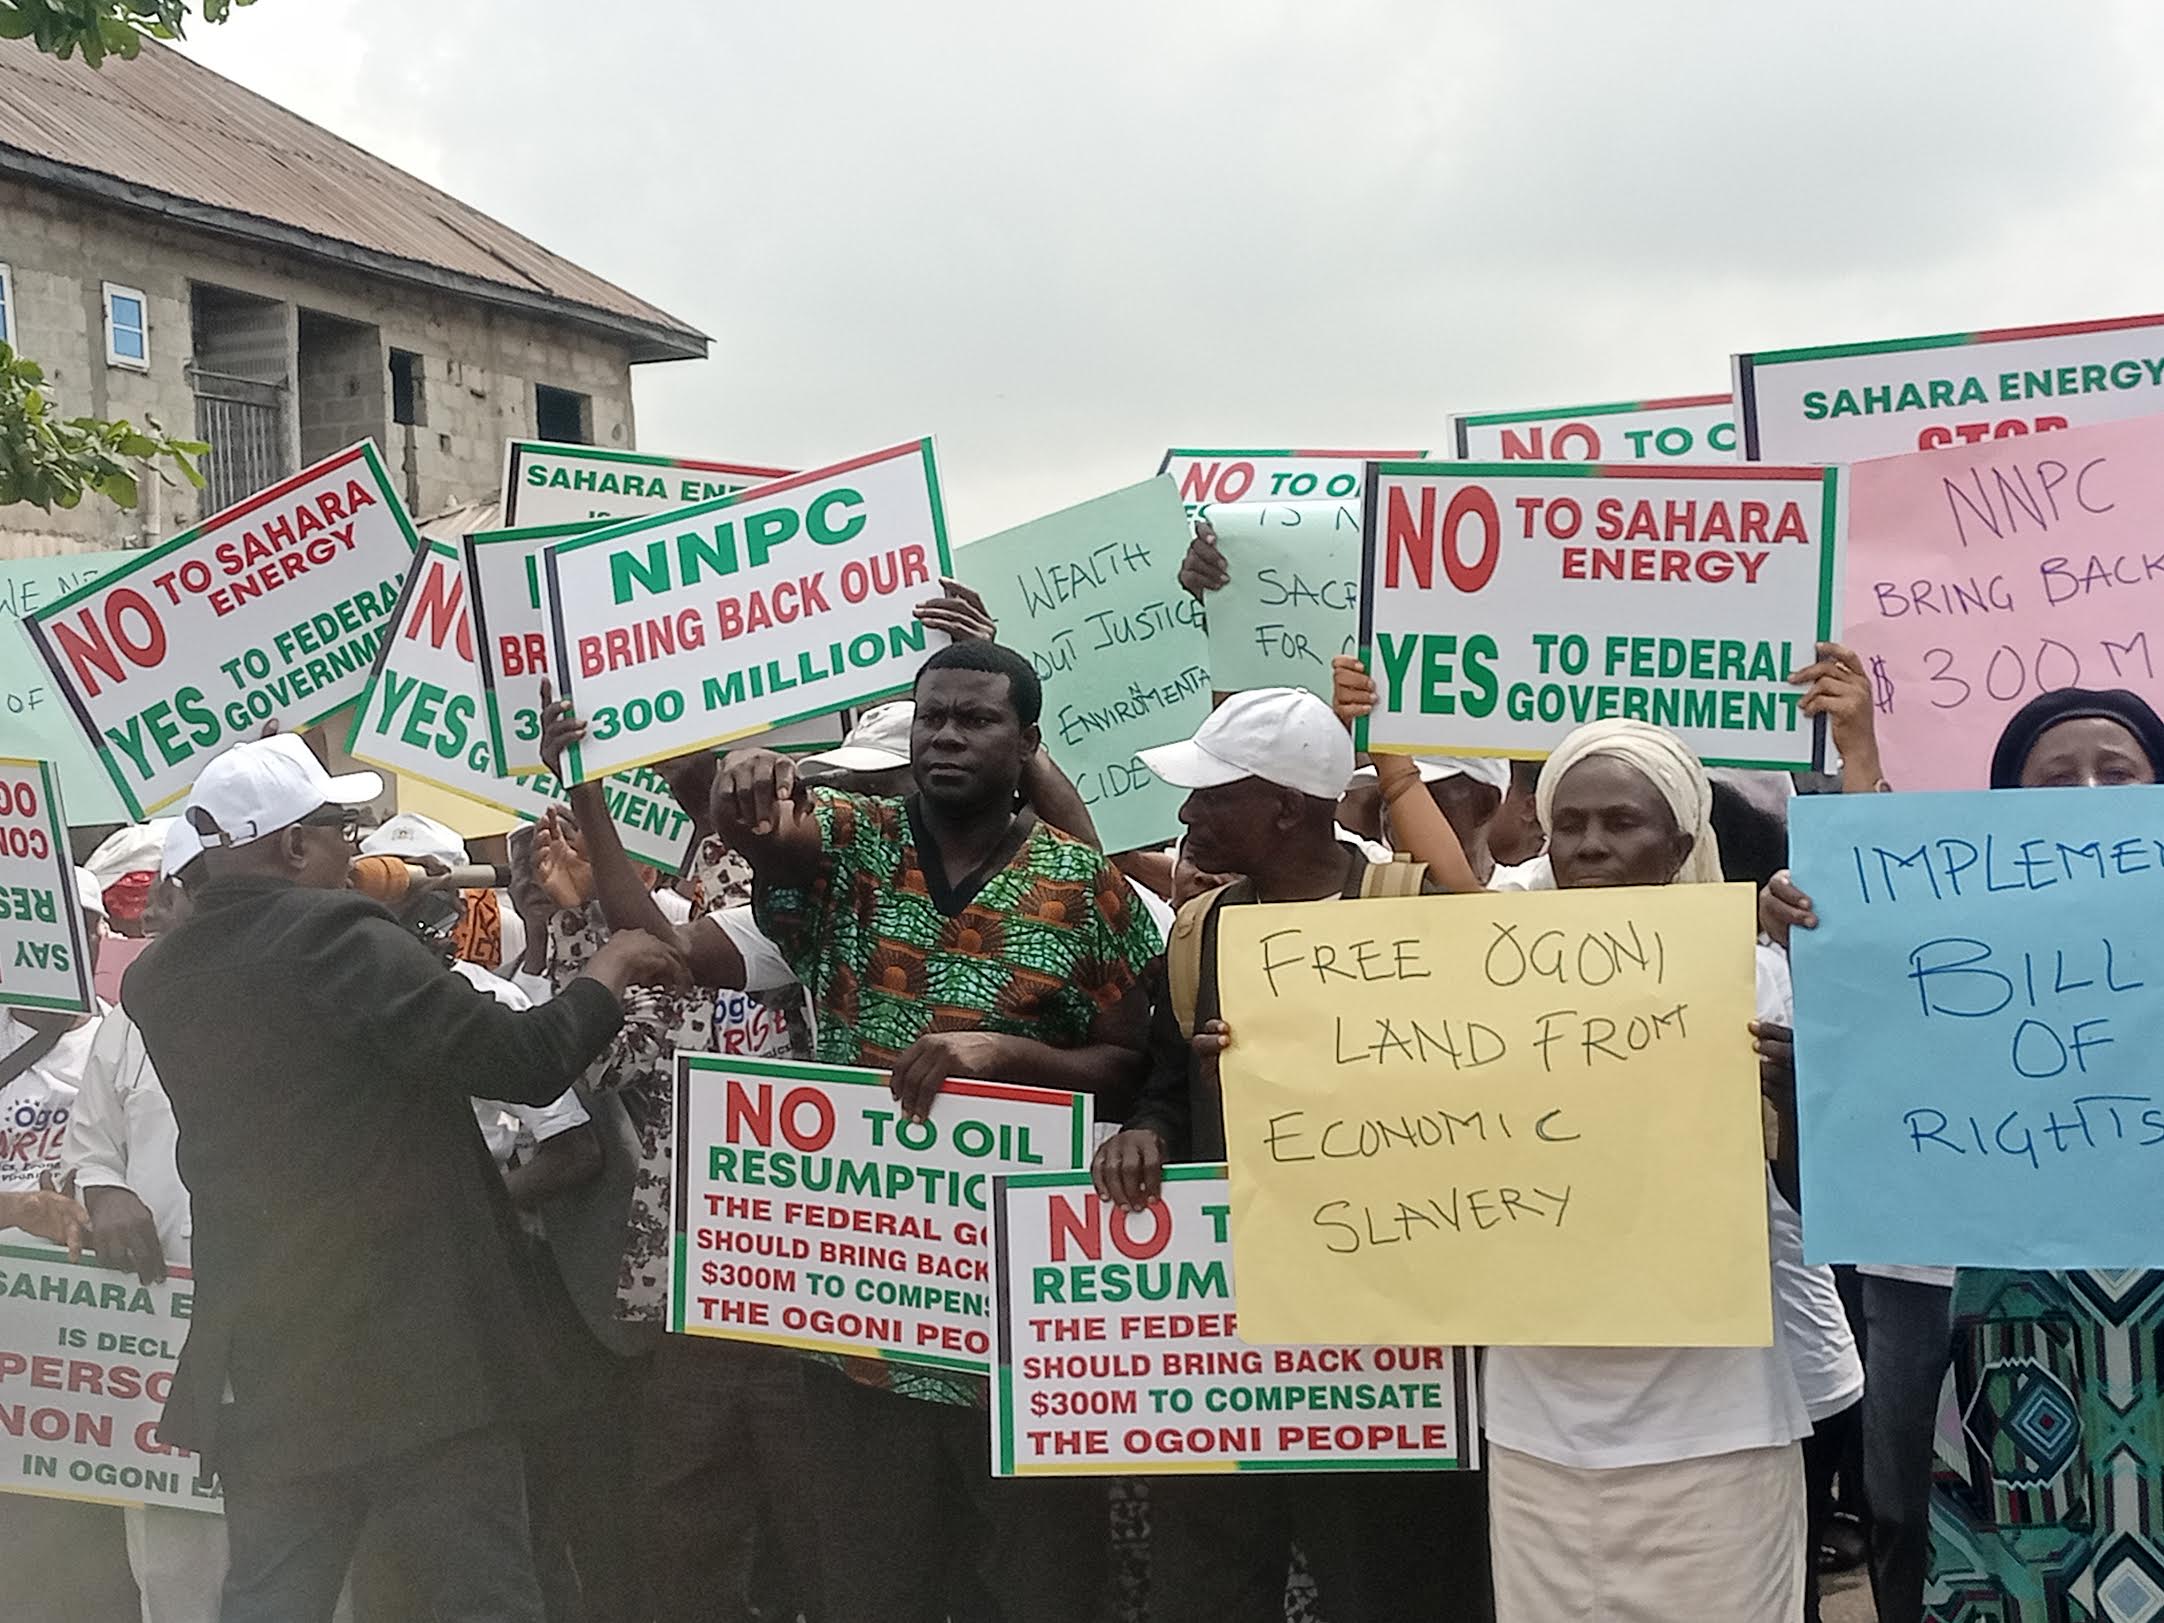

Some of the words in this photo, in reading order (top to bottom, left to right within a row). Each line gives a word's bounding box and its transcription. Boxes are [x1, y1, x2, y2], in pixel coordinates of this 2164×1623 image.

[1803, 376, 1989, 420] SAHARA
[1999, 357, 2164, 402] ENERGY
[1500, 422, 1602, 461] NO
[1624, 426, 1693, 459] TO
[527, 465, 668, 500] SAHARA
[681, 480, 748, 502] EN
[1180, 462, 1255, 503] NO
[1271, 473, 1318, 496] TO
[1943, 458, 2115, 548] NNPC
[610, 488, 868, 605] NNPC
[1384, 485, 1500, 594] NO
[1516, 497, 1583, 540] TO
[1596, 498, 1809, 544] SAHARA
[1561, 547, 1770, 584] ENERGY
[52, 588, 167, 698] NO
[154, 559, 212, 606] TO
[216, 479, 377, 575] SAHARA
[209, 523, 359, 617] ENERGY
[1017, 542, 1152, 619] WEALTH
[1874, 575, 2015, 618] BRING
[2040, 554, 2164, 608] BACK
[579, 608, 705, 679] BRING
[717, 573, 832, 641] BACK
[841, 545, 929, 604] OUR
[1084, 600, 1207, 650] JUSTICE
[1255, 624, 1323, 665] FOR
[7, 687, 44, 713] OF
[106, 688, 221, 781] YES
[221, 643, 271, 691] TO
[274, 573, 404, 666] FEDERA
[592, 689, 684, 740] 300
[702, 621, 927, 712] MILLION
[1376, 632, 1499, 719] YES
[1533, 634, 1589, 676] TO
[1605, 636, 1794, 683] FEDERAL
[376, 668, 475, 759] YES
[1507, 682, 1801, 732] GOVERNMENT
[15, 940, 70, 972] SAY
[1260, 928, 1431, 997] FREE
[1485, 920, 1665, 987] OGONI
[1908, 938, 2144, 1017] BILL
[1335, 1016, 1507, 1070] LAND
[1533, 1004, 1689, 1072] FROM
[2012, 1019, 2114, 1078] OF
[726, 1080, 836, 1152] NO
[862, 1110, 937, 1151] TO
[952, 1119, 1043, 1165] OIL
[1263, 1109, 1581, 1162] ECONOMIC
[1903, 1095, 2164, 1169] RIGHTS
[704, 1193, 772, 1221] THE
[784, 1202, 942, 1241] FEDERAL
[1048, 1193, 1172, 1262] NO
[1201, 1205, 1231, 1243] T
[1313, 1186, 1572, 1254] SLAVERY
[697, 1229, 809, 1259] SHOULD
[820, 1242, 907, 1271] BRING
[918, 1255, 988, 1282] BACK
[702, 1261, 796, 1293] $300M
[806, 1272, 845, 1298] TO
[1032, 1259, 1229, 1304] RESUM
[58, 1327, 88, 1348] IS
[697, 1296, 769, 1326] THE
[782, 1306, 902, 1343] OGONI
[916, 1322, 990, 1354] PEO
[1029, 1317, 1107, 1342] THE
[1023, 1353, 1151, 1379] SHOULD
[1162, 1350, 1263, 1376] BRING
[1275, 1348, 1362, 1374] BACK
[1373, 1346, 1445, 1372] OUR
[0, 1403, 113, 1447] NON
[1030, 1389, 1137, 1416] $300M
[1148, 1388, 1193, 1414] TO
[1205, 1383, 1443, 1412] COMPENSATE
[1027, 1430, 1109, 1456] THE
[1123, 1426, 1261, 1455] OGONI
[1278, 1424, 1448, 1452] PEOPLE
[22, 1454, 57, 1477] IN
[69, 1460, 179, 1494] OGONI
